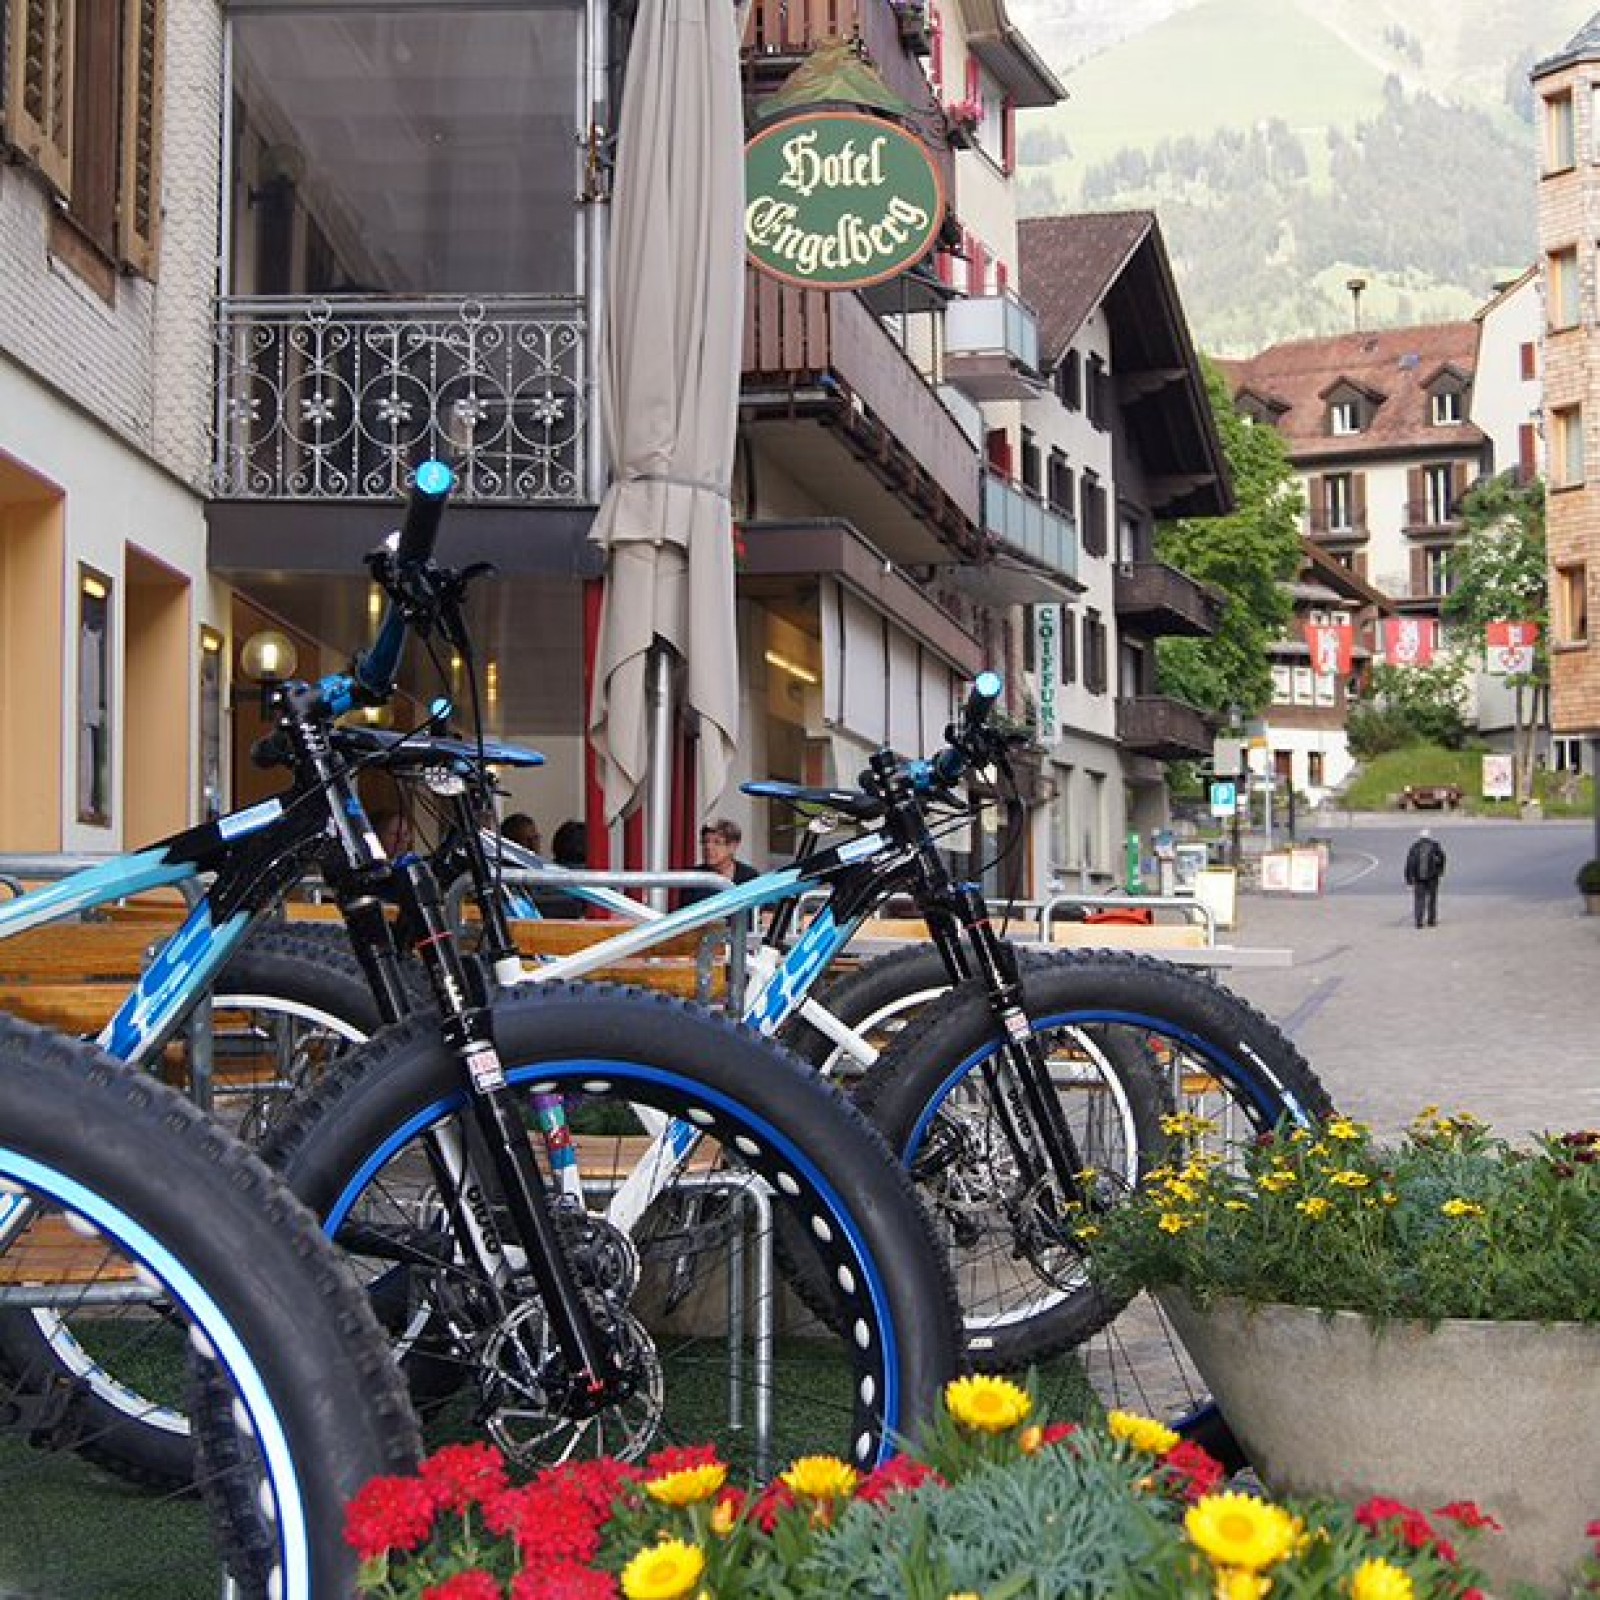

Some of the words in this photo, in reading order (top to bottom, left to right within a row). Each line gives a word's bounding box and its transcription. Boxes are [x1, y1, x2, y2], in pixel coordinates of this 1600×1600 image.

[777, 129, 889, 196] Hotel
[744, 195, 929, 275] Engelberg
[1038, 607, 1055, 738] COIFFURE
